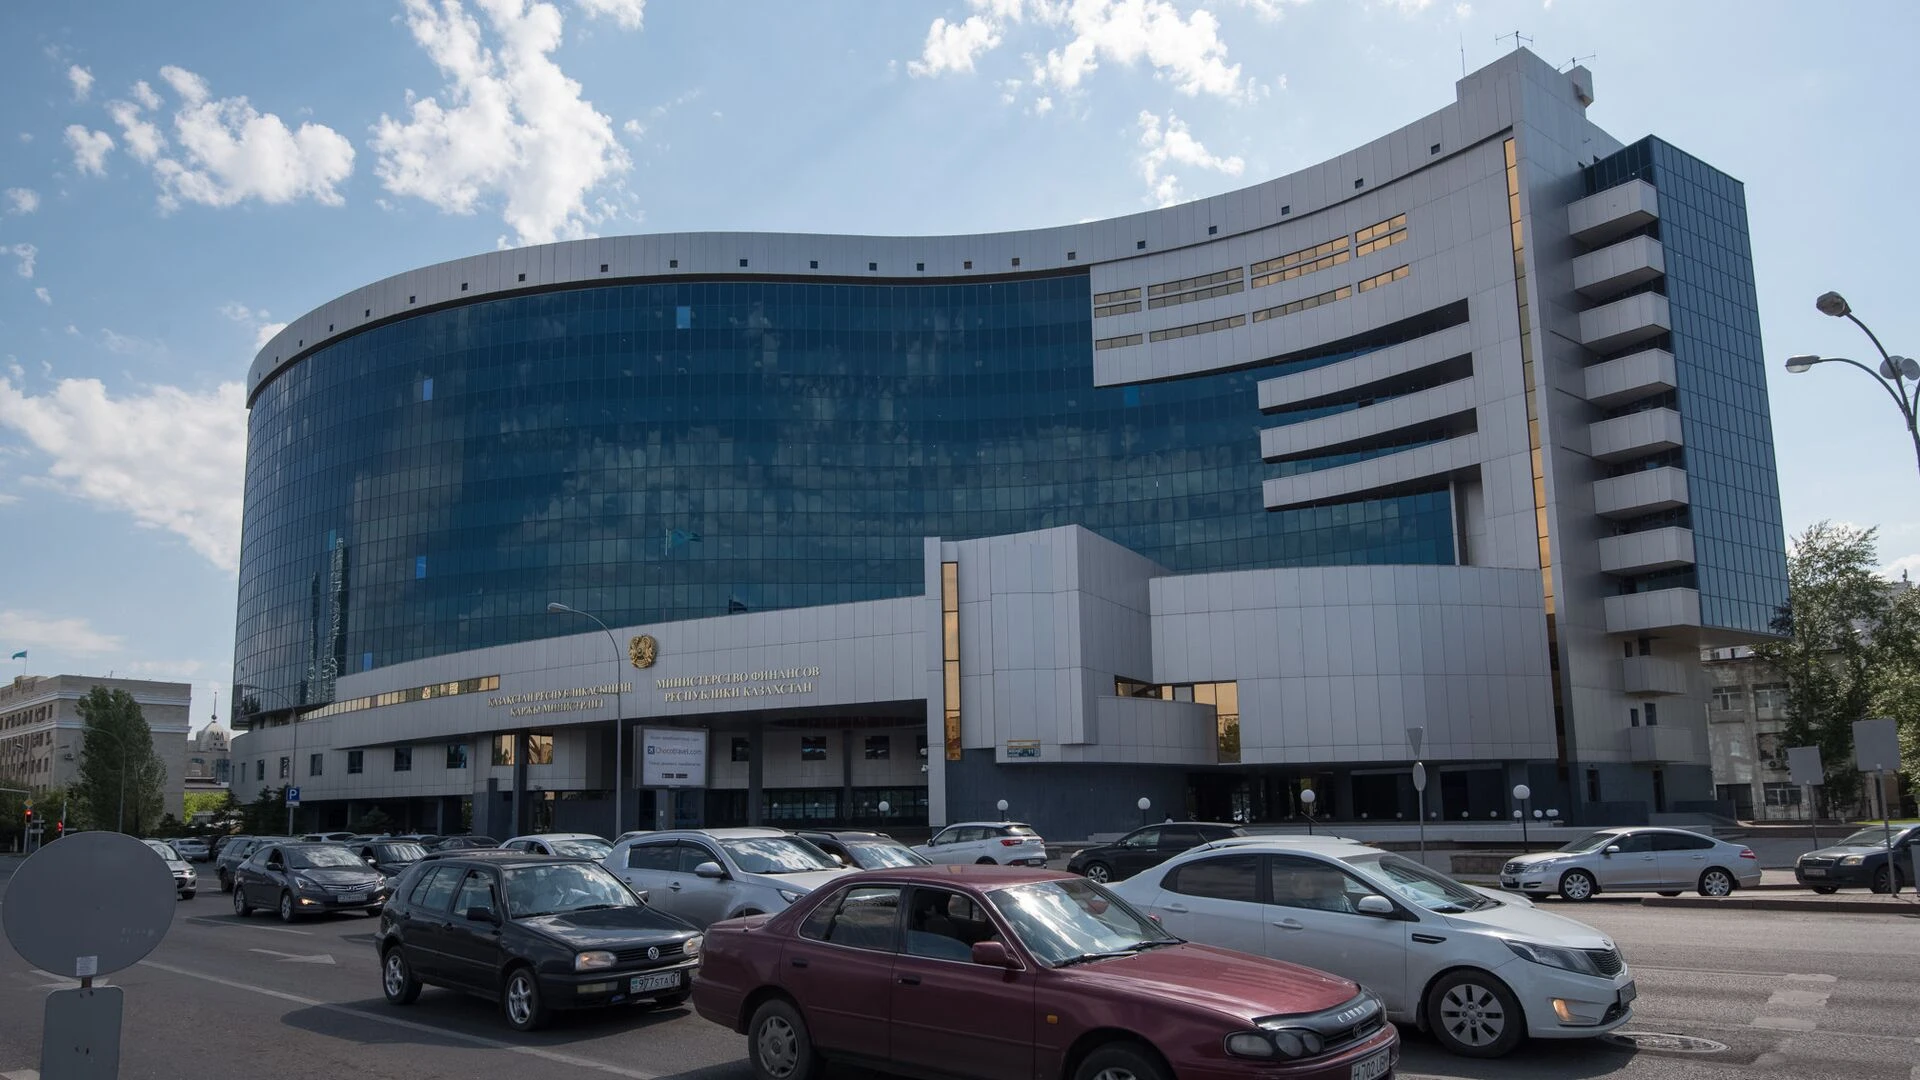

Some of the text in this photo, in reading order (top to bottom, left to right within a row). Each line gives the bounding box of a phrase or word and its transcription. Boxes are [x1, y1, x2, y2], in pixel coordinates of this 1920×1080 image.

[656, 666, 820, 689] МИНИСТЕРСТВО ФИНАНСОВ
[664, 682, 812, 702] РЕСПУБЛИКИ КАЗАХСТАН
[289, 789, 297, 800] P
